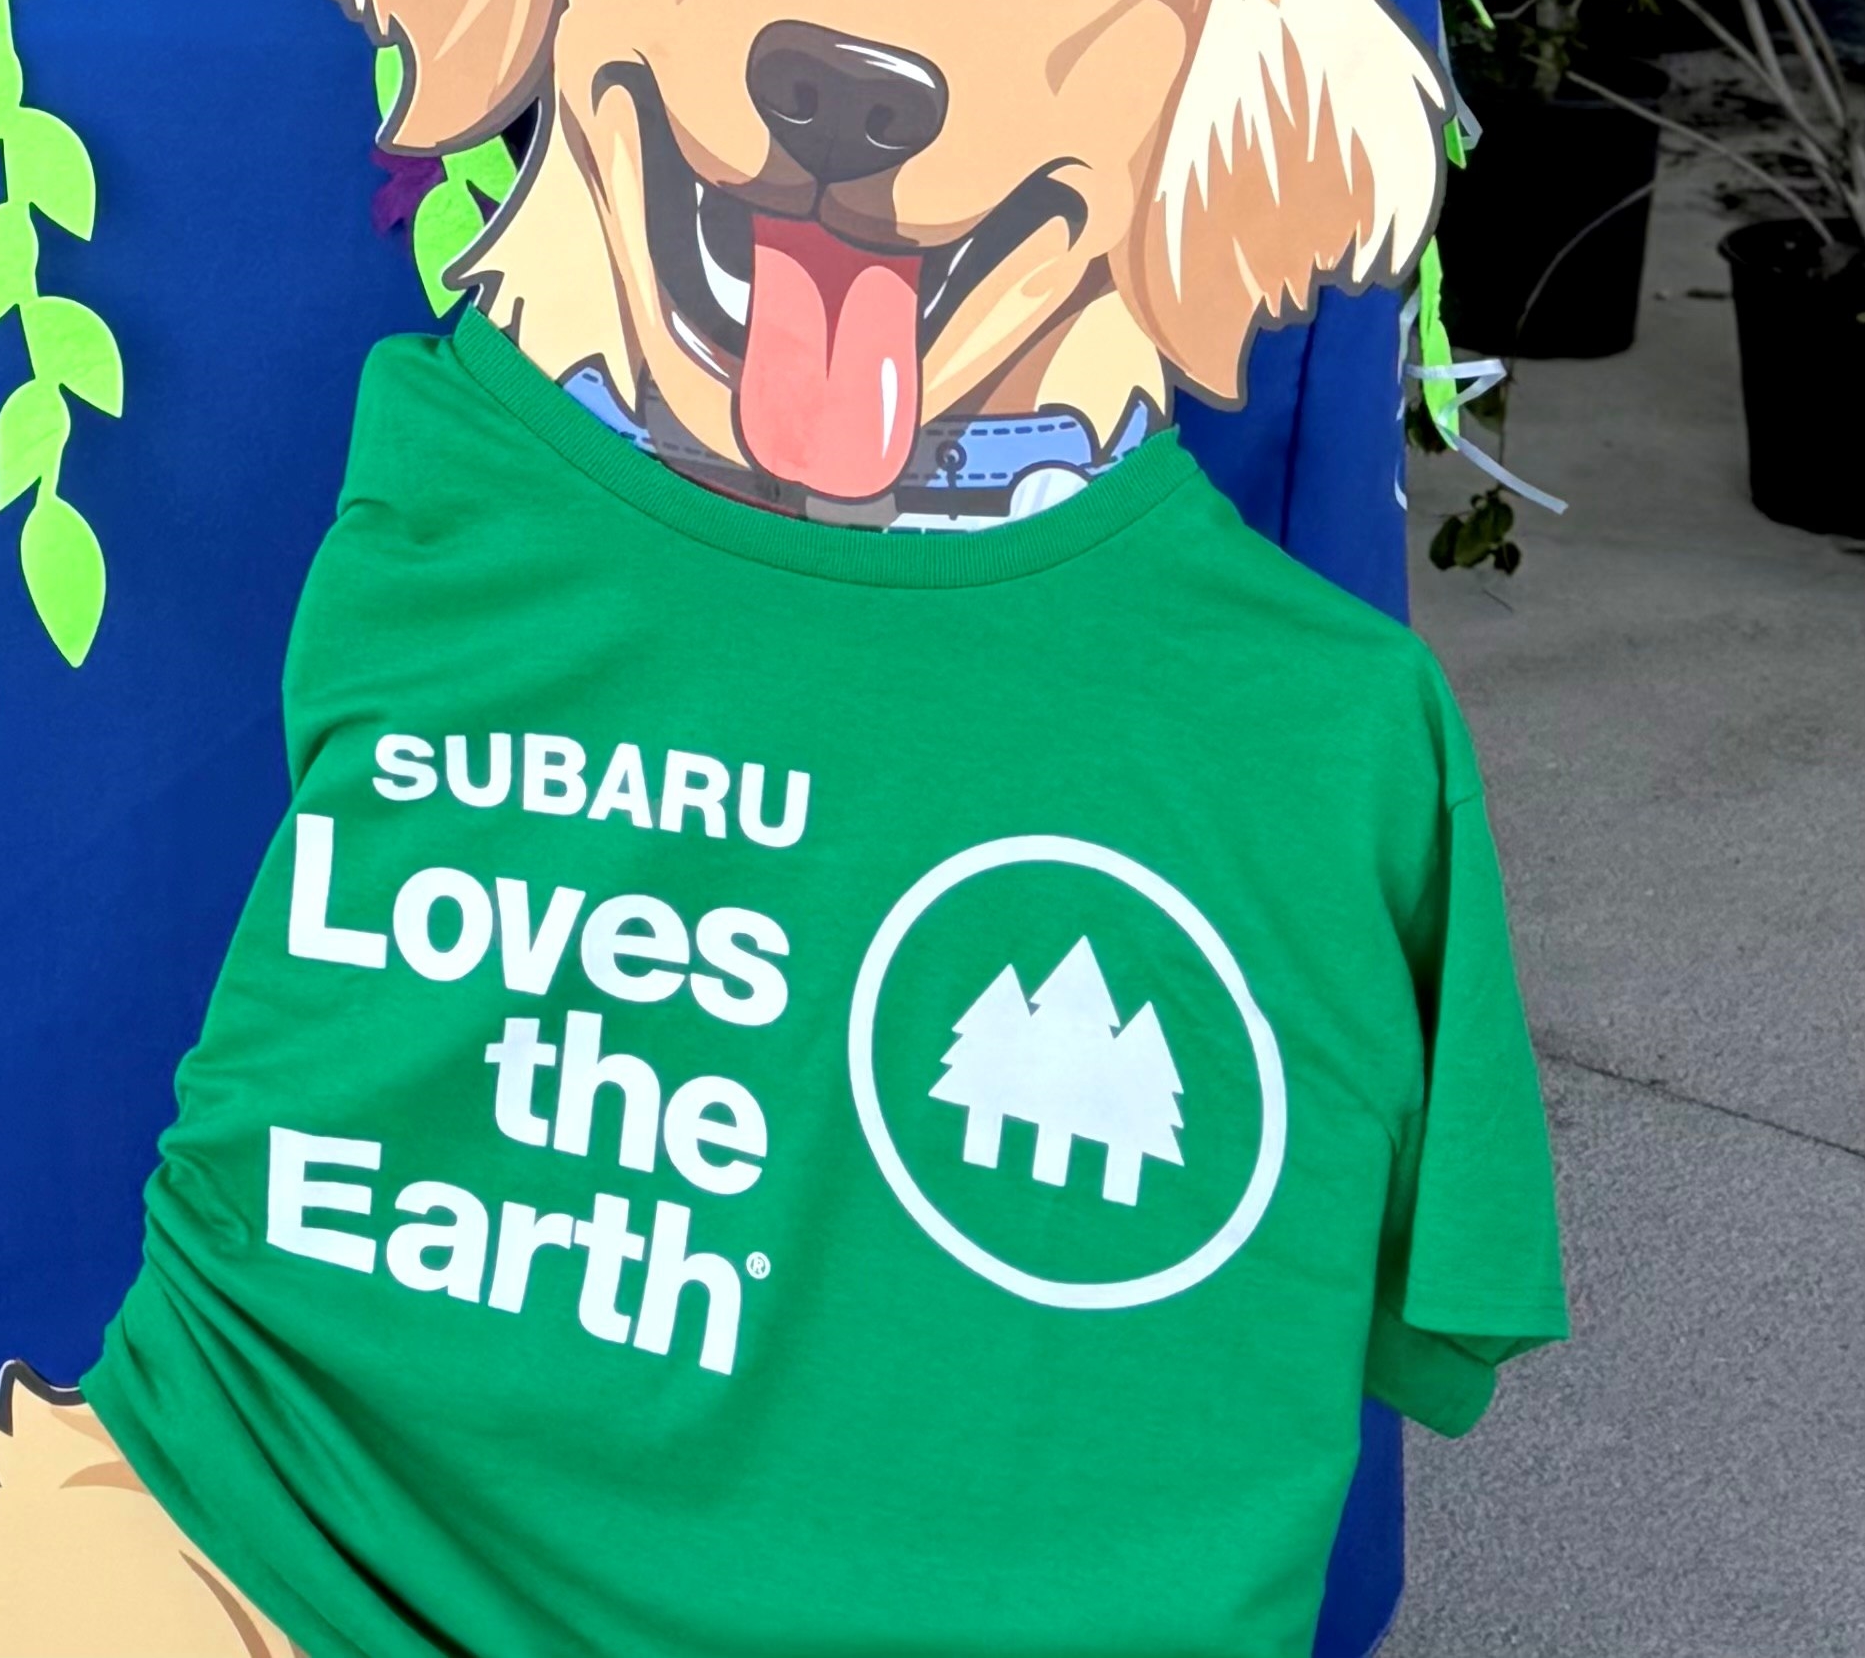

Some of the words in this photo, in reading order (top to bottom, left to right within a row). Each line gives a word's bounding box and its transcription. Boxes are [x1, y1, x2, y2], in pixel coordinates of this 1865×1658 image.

[372, 732, 811, 848] SUBARU
[288, 813, 790, 1026] Loves
[485, 1010, 768, 1195] the
